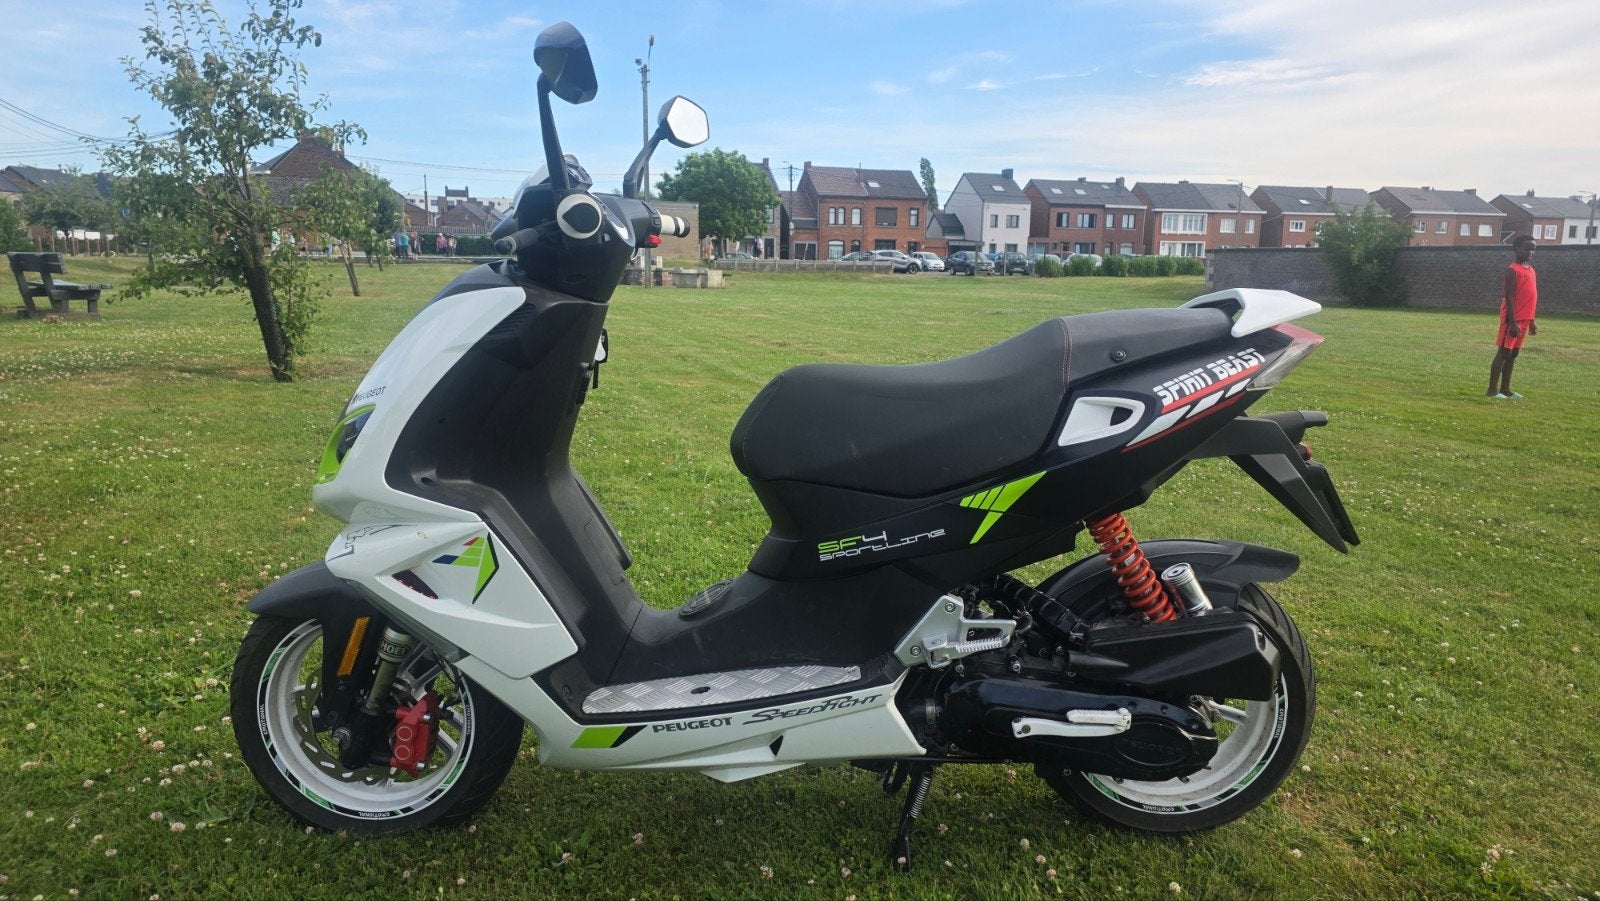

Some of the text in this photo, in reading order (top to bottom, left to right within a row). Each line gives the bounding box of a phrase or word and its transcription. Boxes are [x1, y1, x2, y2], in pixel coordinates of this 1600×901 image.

[1152, 347, 1266, 407] SPIRIT BEAST
[818, 530, 888, 554] SF4
[652, 716, 733, 733] PEUGEOT
